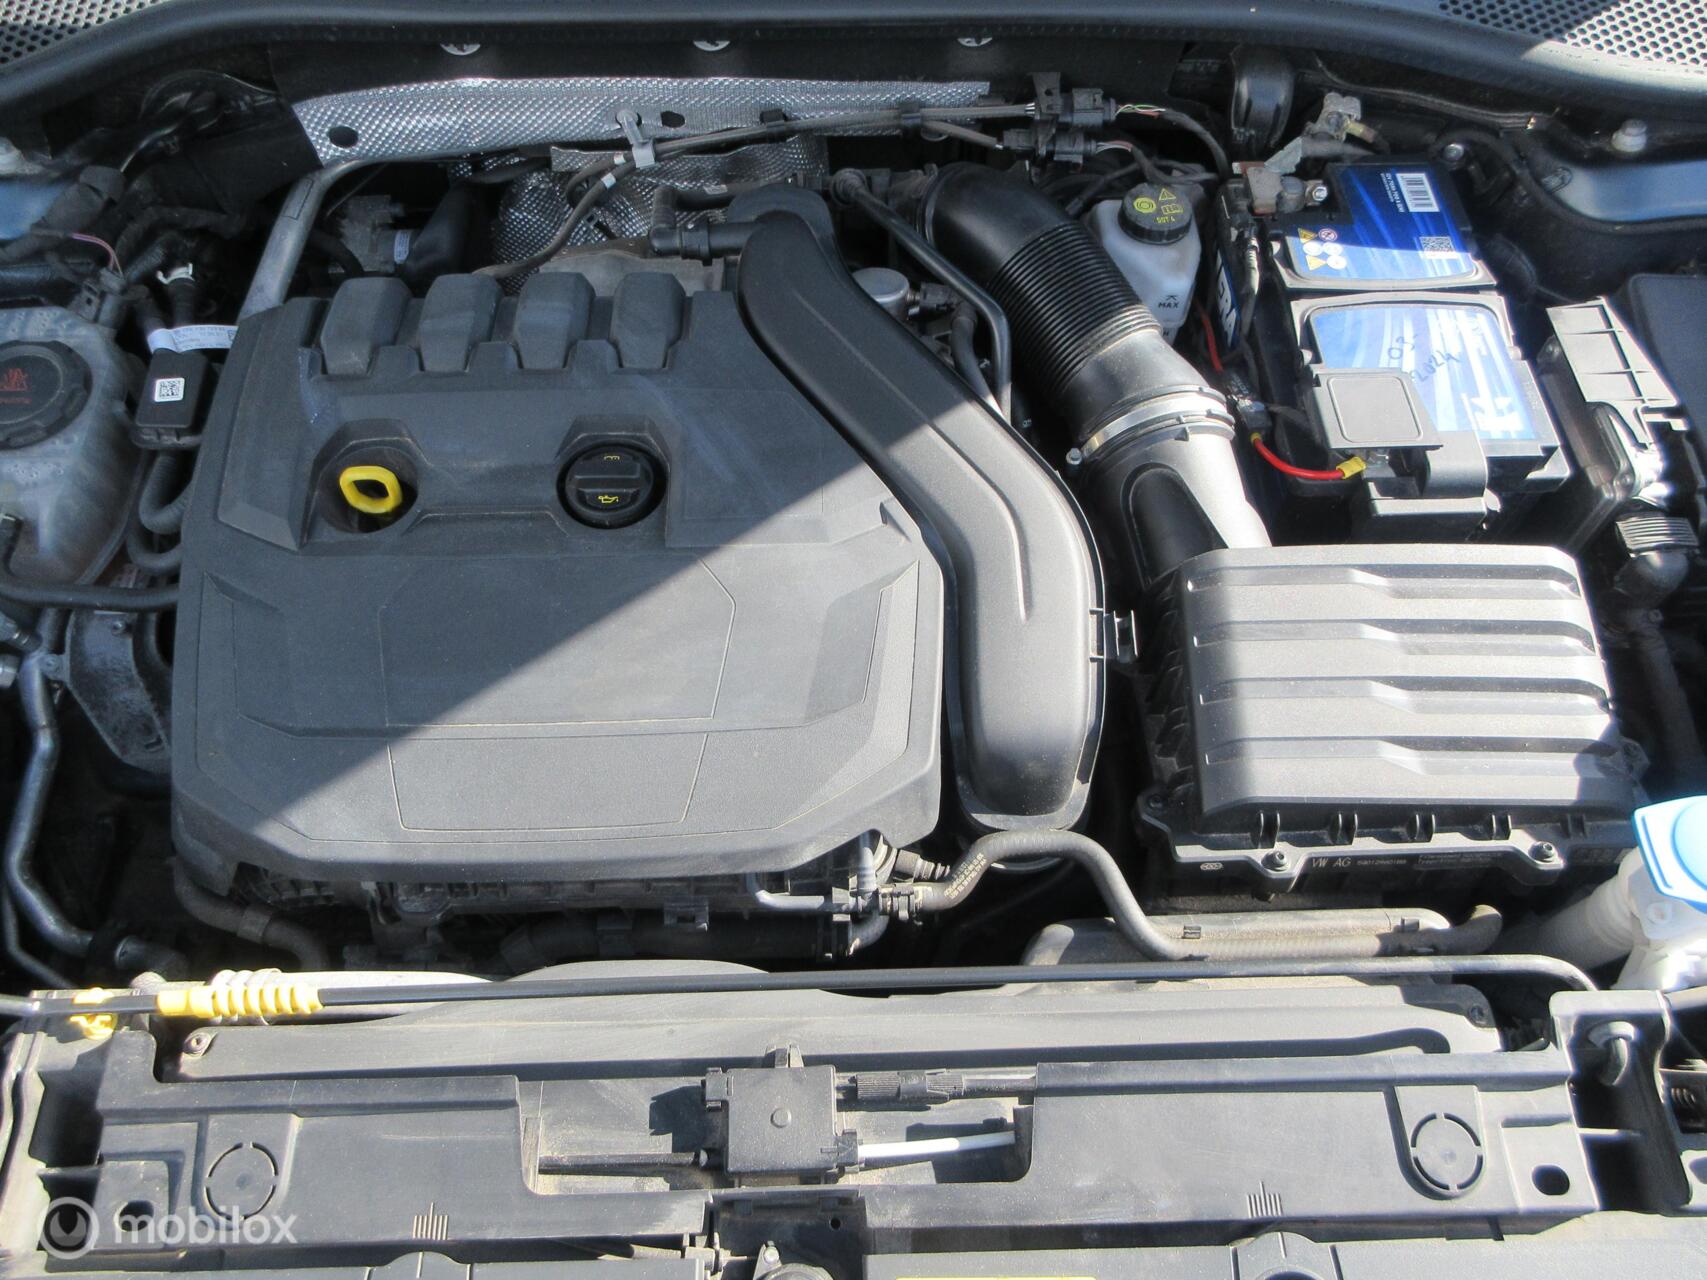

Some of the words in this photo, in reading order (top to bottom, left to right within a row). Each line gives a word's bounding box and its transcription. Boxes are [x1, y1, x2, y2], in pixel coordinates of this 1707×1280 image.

[1157, 301, 1180, 309] MAX
[1311, 857, 1328, 868] VW
[1332, 856, 1352, 868] AG
